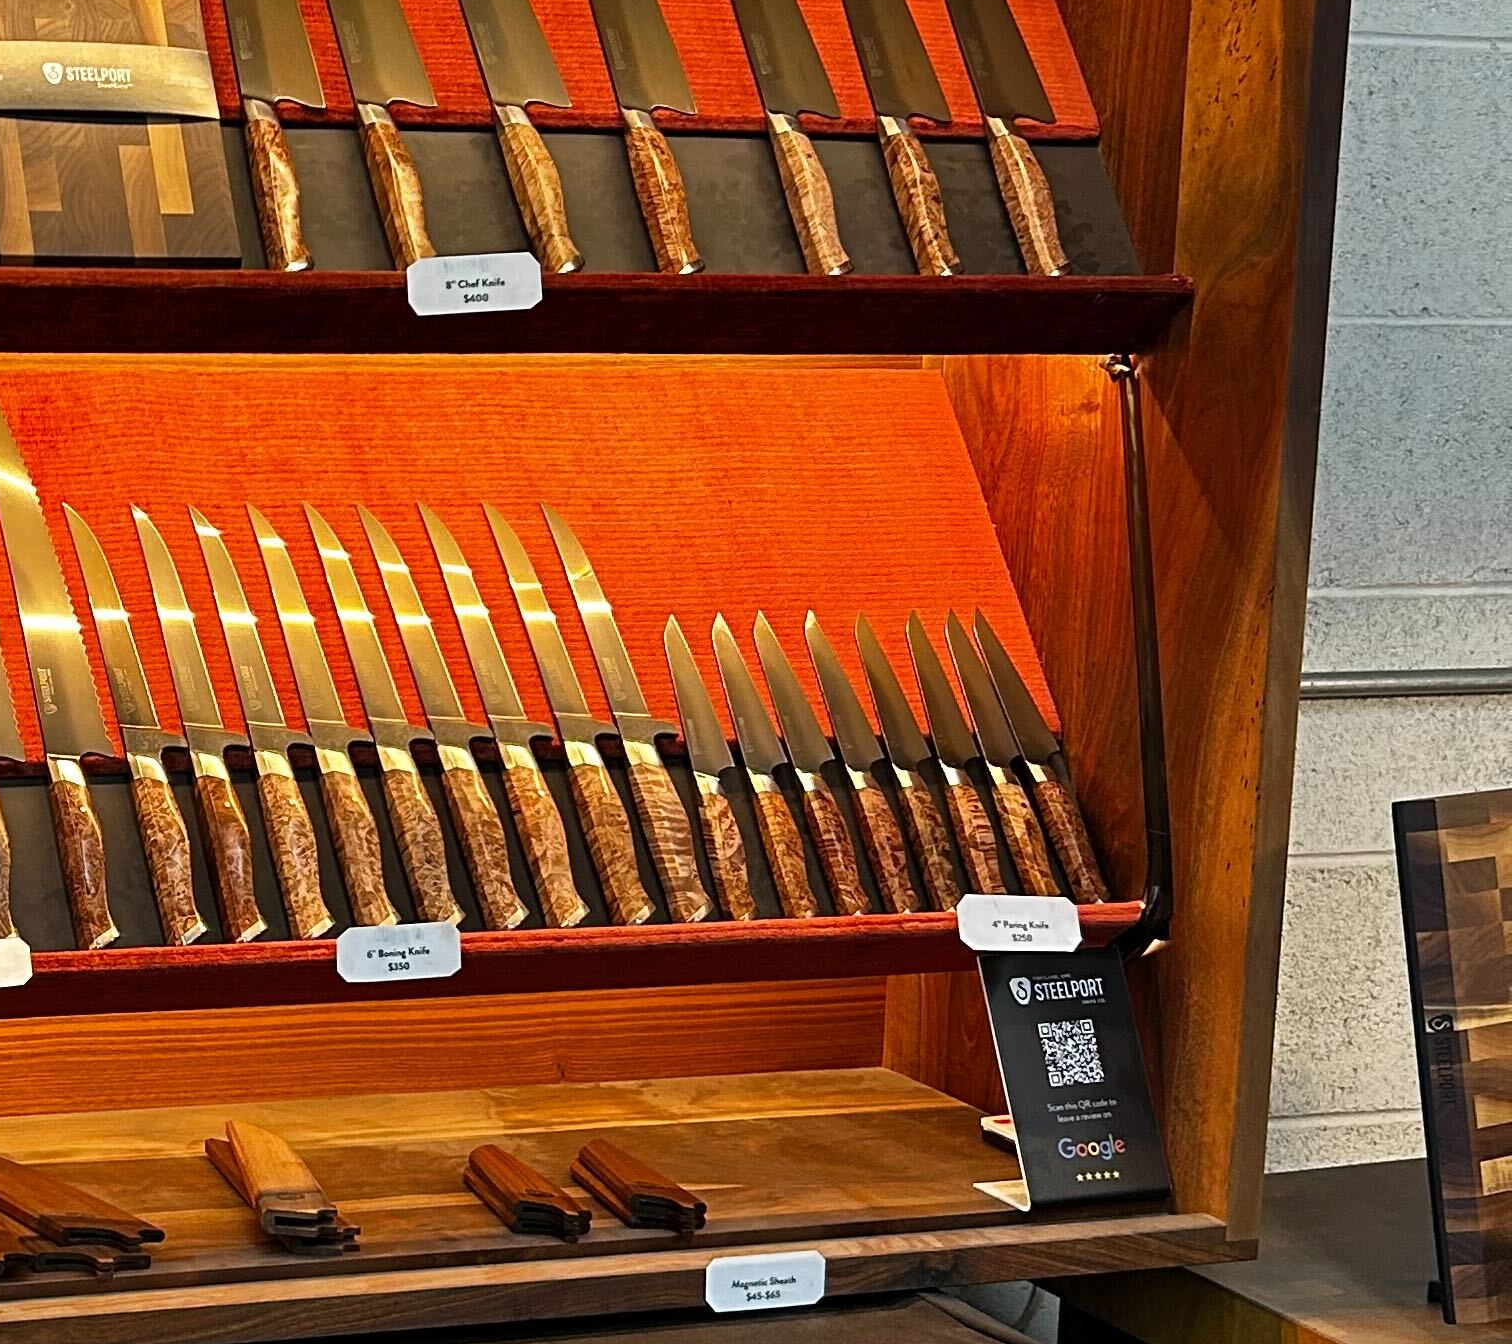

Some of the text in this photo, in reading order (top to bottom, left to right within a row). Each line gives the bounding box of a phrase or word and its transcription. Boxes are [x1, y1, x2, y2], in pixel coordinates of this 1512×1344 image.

[66, 66, 132, 83] STEELPORT
[458, 278, 479, 289] Chef
[482, 278, 505, 287] Knife
[1029, 920, 1049, 929] Knife
[378, 948, 406, 959] Boning
[408, 946, 430, 955] Knife
[1034, 978, 1103, 1001] STEELPORT
[1047, 1103, 1064, 1112] Scan
[1078, 1099, 1091, 1110] QR
[1058, 1133, 1126, 1160] Google
[731, 1277, 768, 1290] Magnetic
